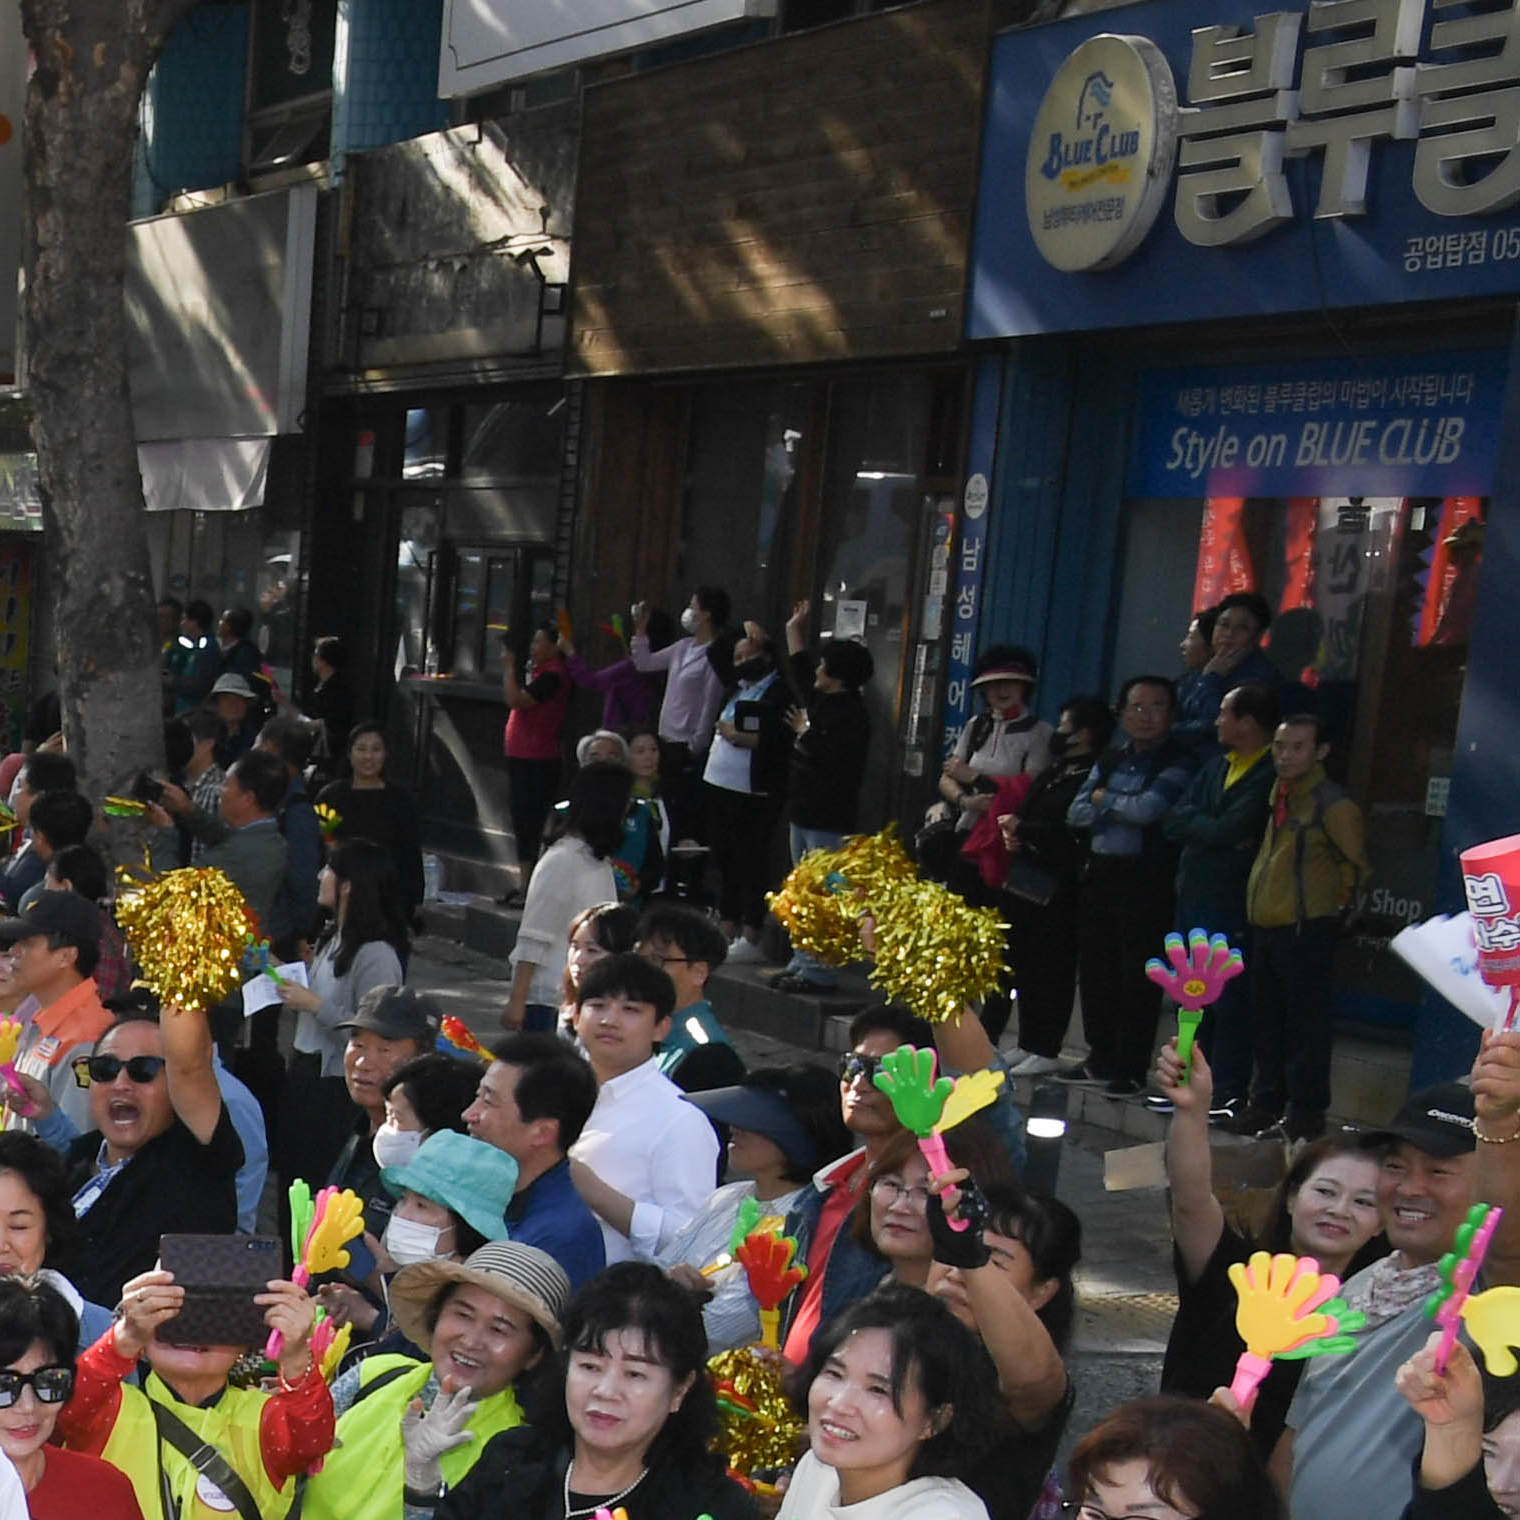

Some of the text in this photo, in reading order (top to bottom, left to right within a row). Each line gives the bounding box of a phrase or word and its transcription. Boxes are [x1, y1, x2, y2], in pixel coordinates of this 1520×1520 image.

[1404, 230, 1487, 272] 공업탑점
[1166, 417, 1466, 479] Style on BLUE CLUB
